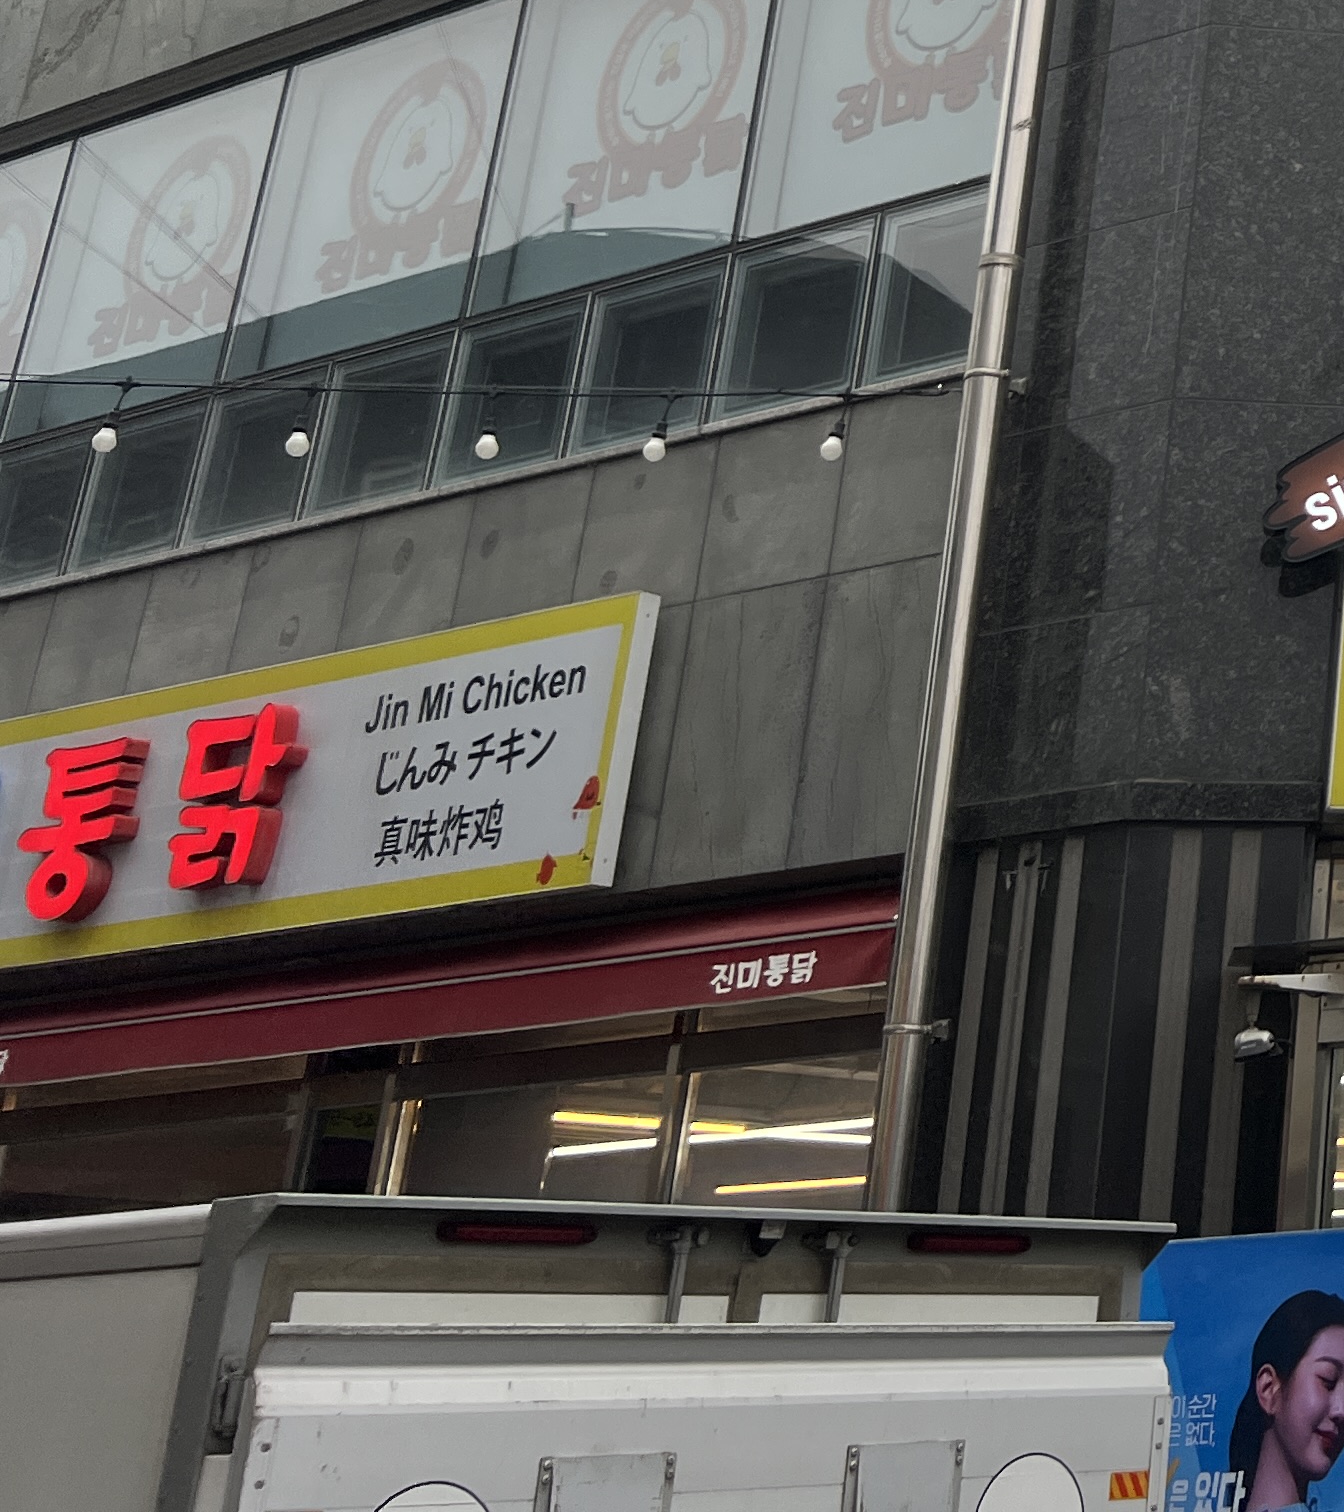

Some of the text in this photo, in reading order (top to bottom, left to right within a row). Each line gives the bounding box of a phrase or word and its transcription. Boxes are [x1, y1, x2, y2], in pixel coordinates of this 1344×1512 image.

[364, 661, 588, 735] Jin Mi Chicken
[375, 727, 558, 799] じんみ チキン
[17, 702, 310, 924] 통닭
[373, 803, 505, 869] 真味炸鸡
[709, 950, 819, 996] 진미통닭
